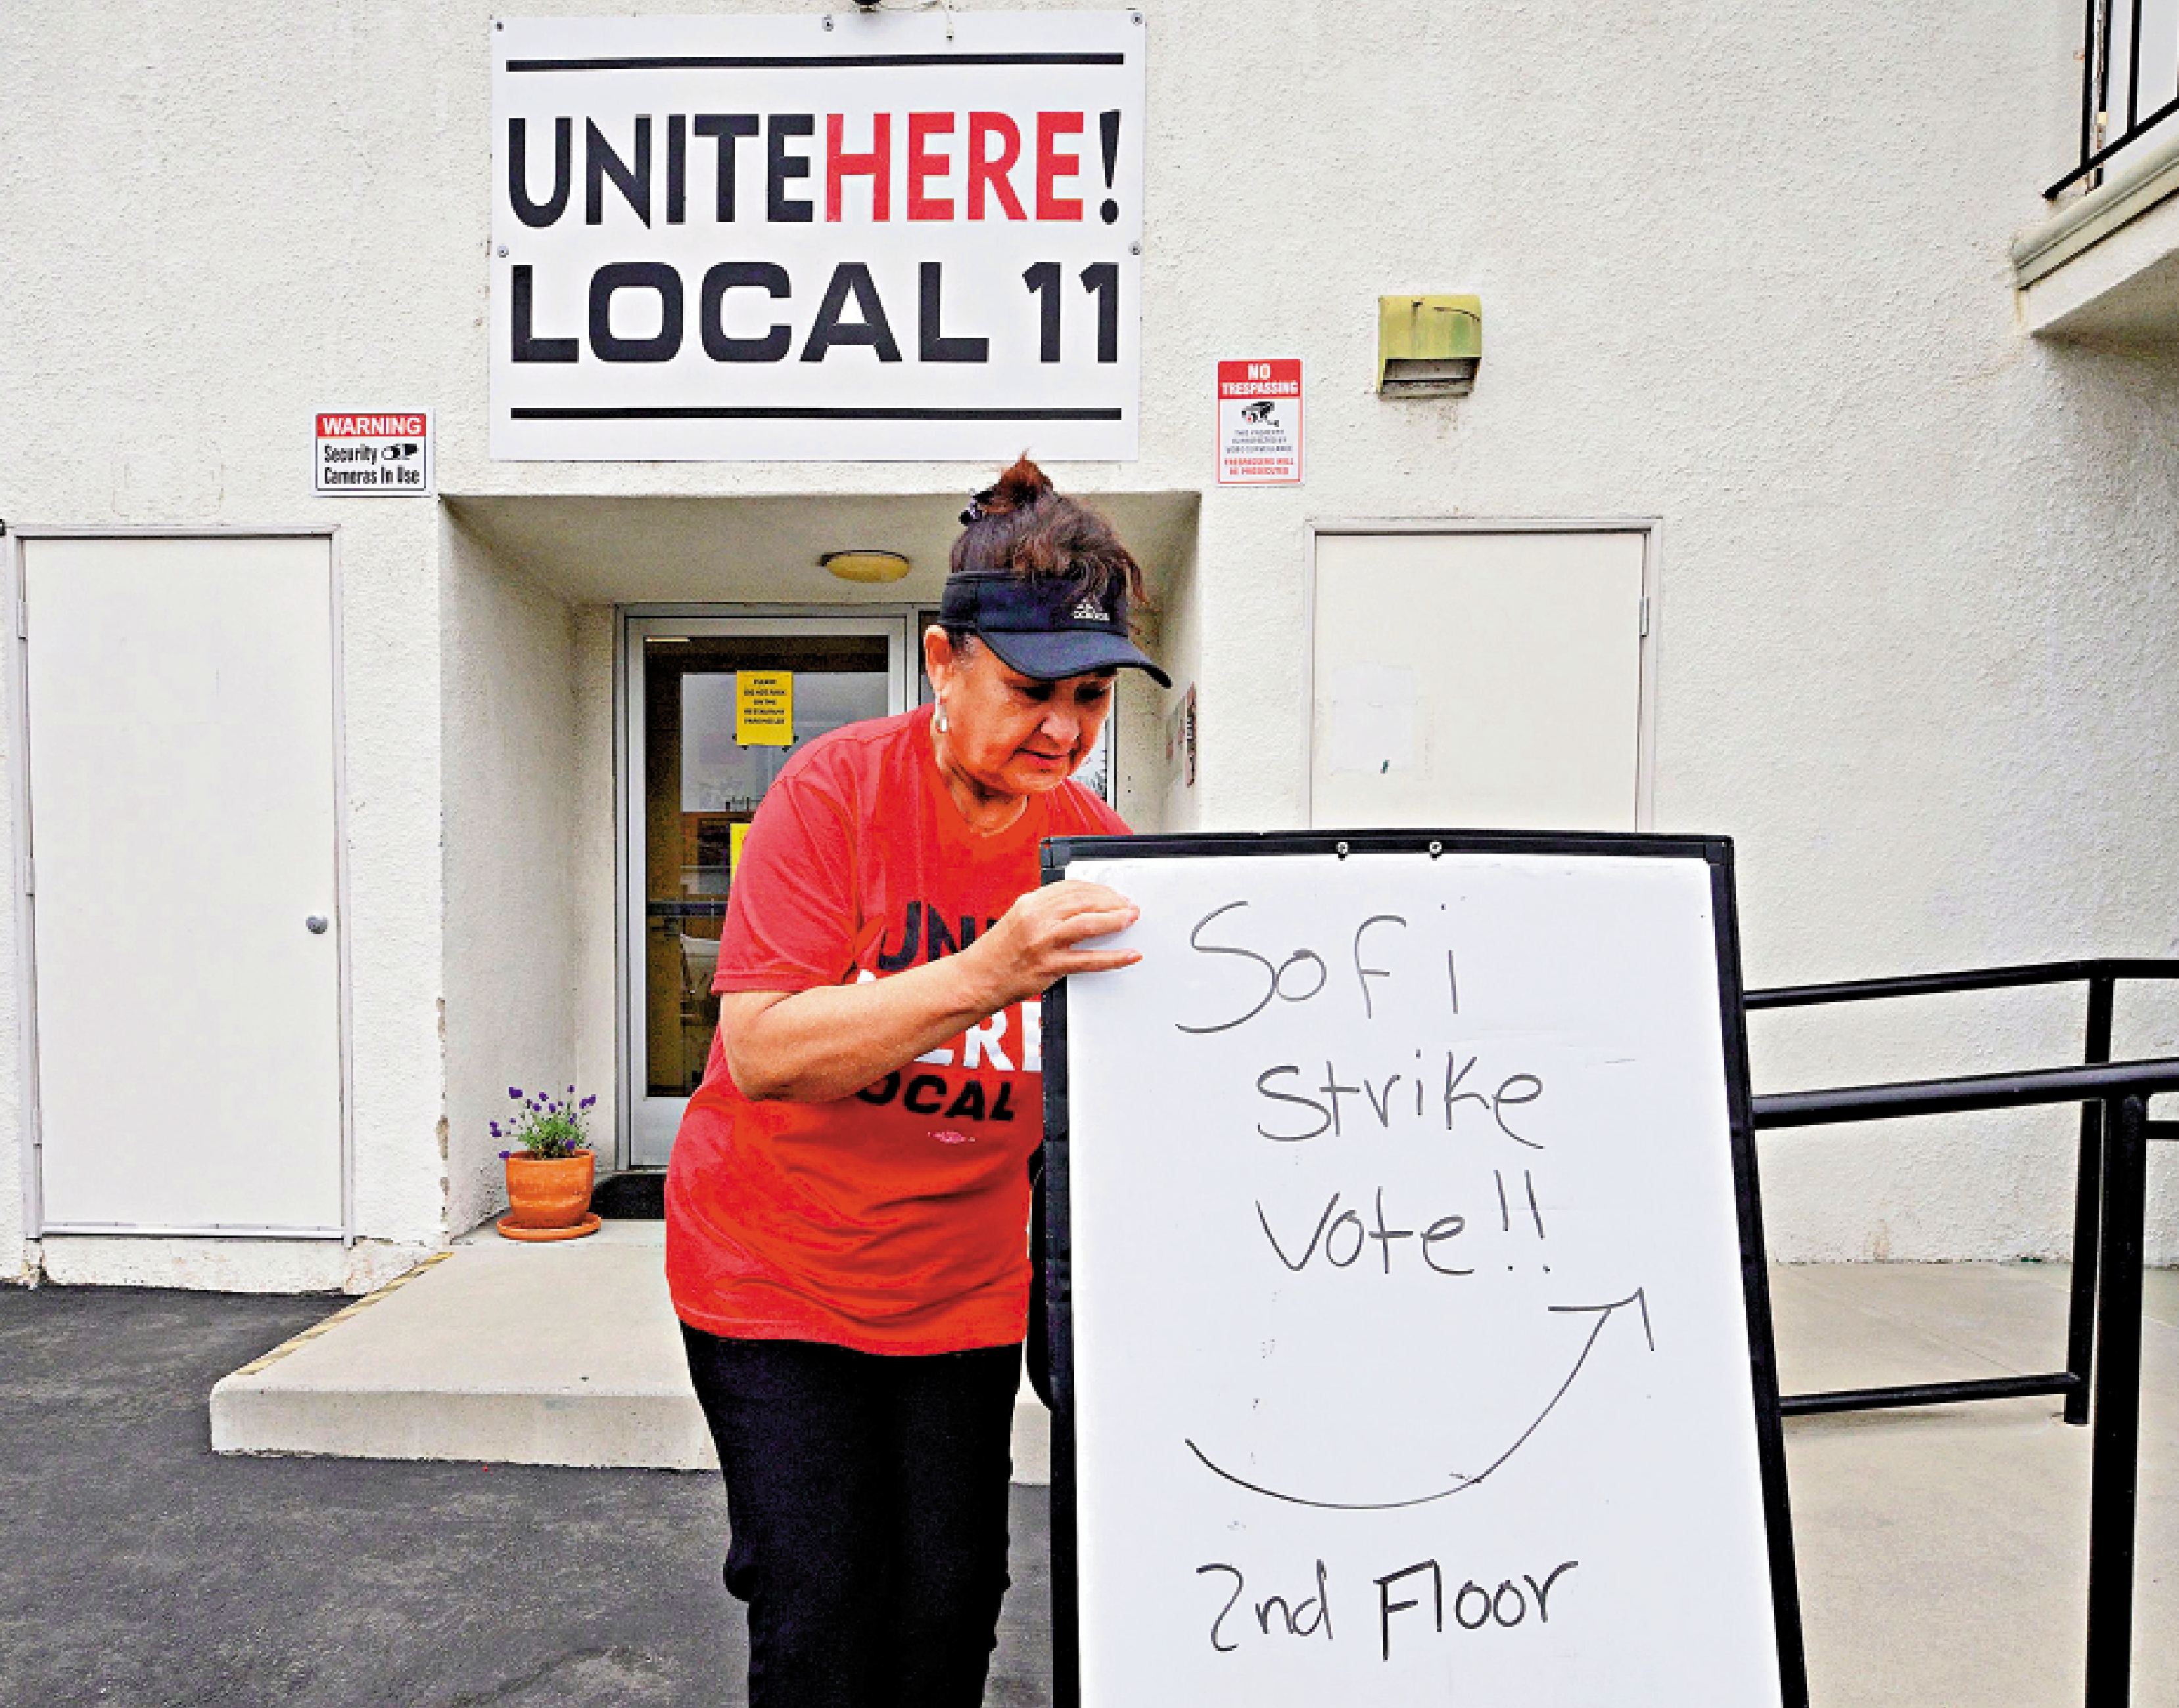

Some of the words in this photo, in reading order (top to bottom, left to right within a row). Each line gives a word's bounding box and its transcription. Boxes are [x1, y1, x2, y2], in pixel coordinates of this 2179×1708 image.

[511, 262, 990, 363] LOCAL
[1021, 262, 1119, 363] 11
[1248, 363, 1271, 381] NO
[1222, 380, 1299, 396] TRESPASSING
[323, 417, 421, 435] WARNING
[324, 444, 377, 465] Security
[324, 467, 377, 484] Cameras
[381, 465, 394, 484] In
[397, 465, 420, 484] Use
[856, 1070, 1015, 1121] OCAL
[1196, 1558, 1333, 1651] 2nd
[1374, 1558, 1579, 1661] Floor
